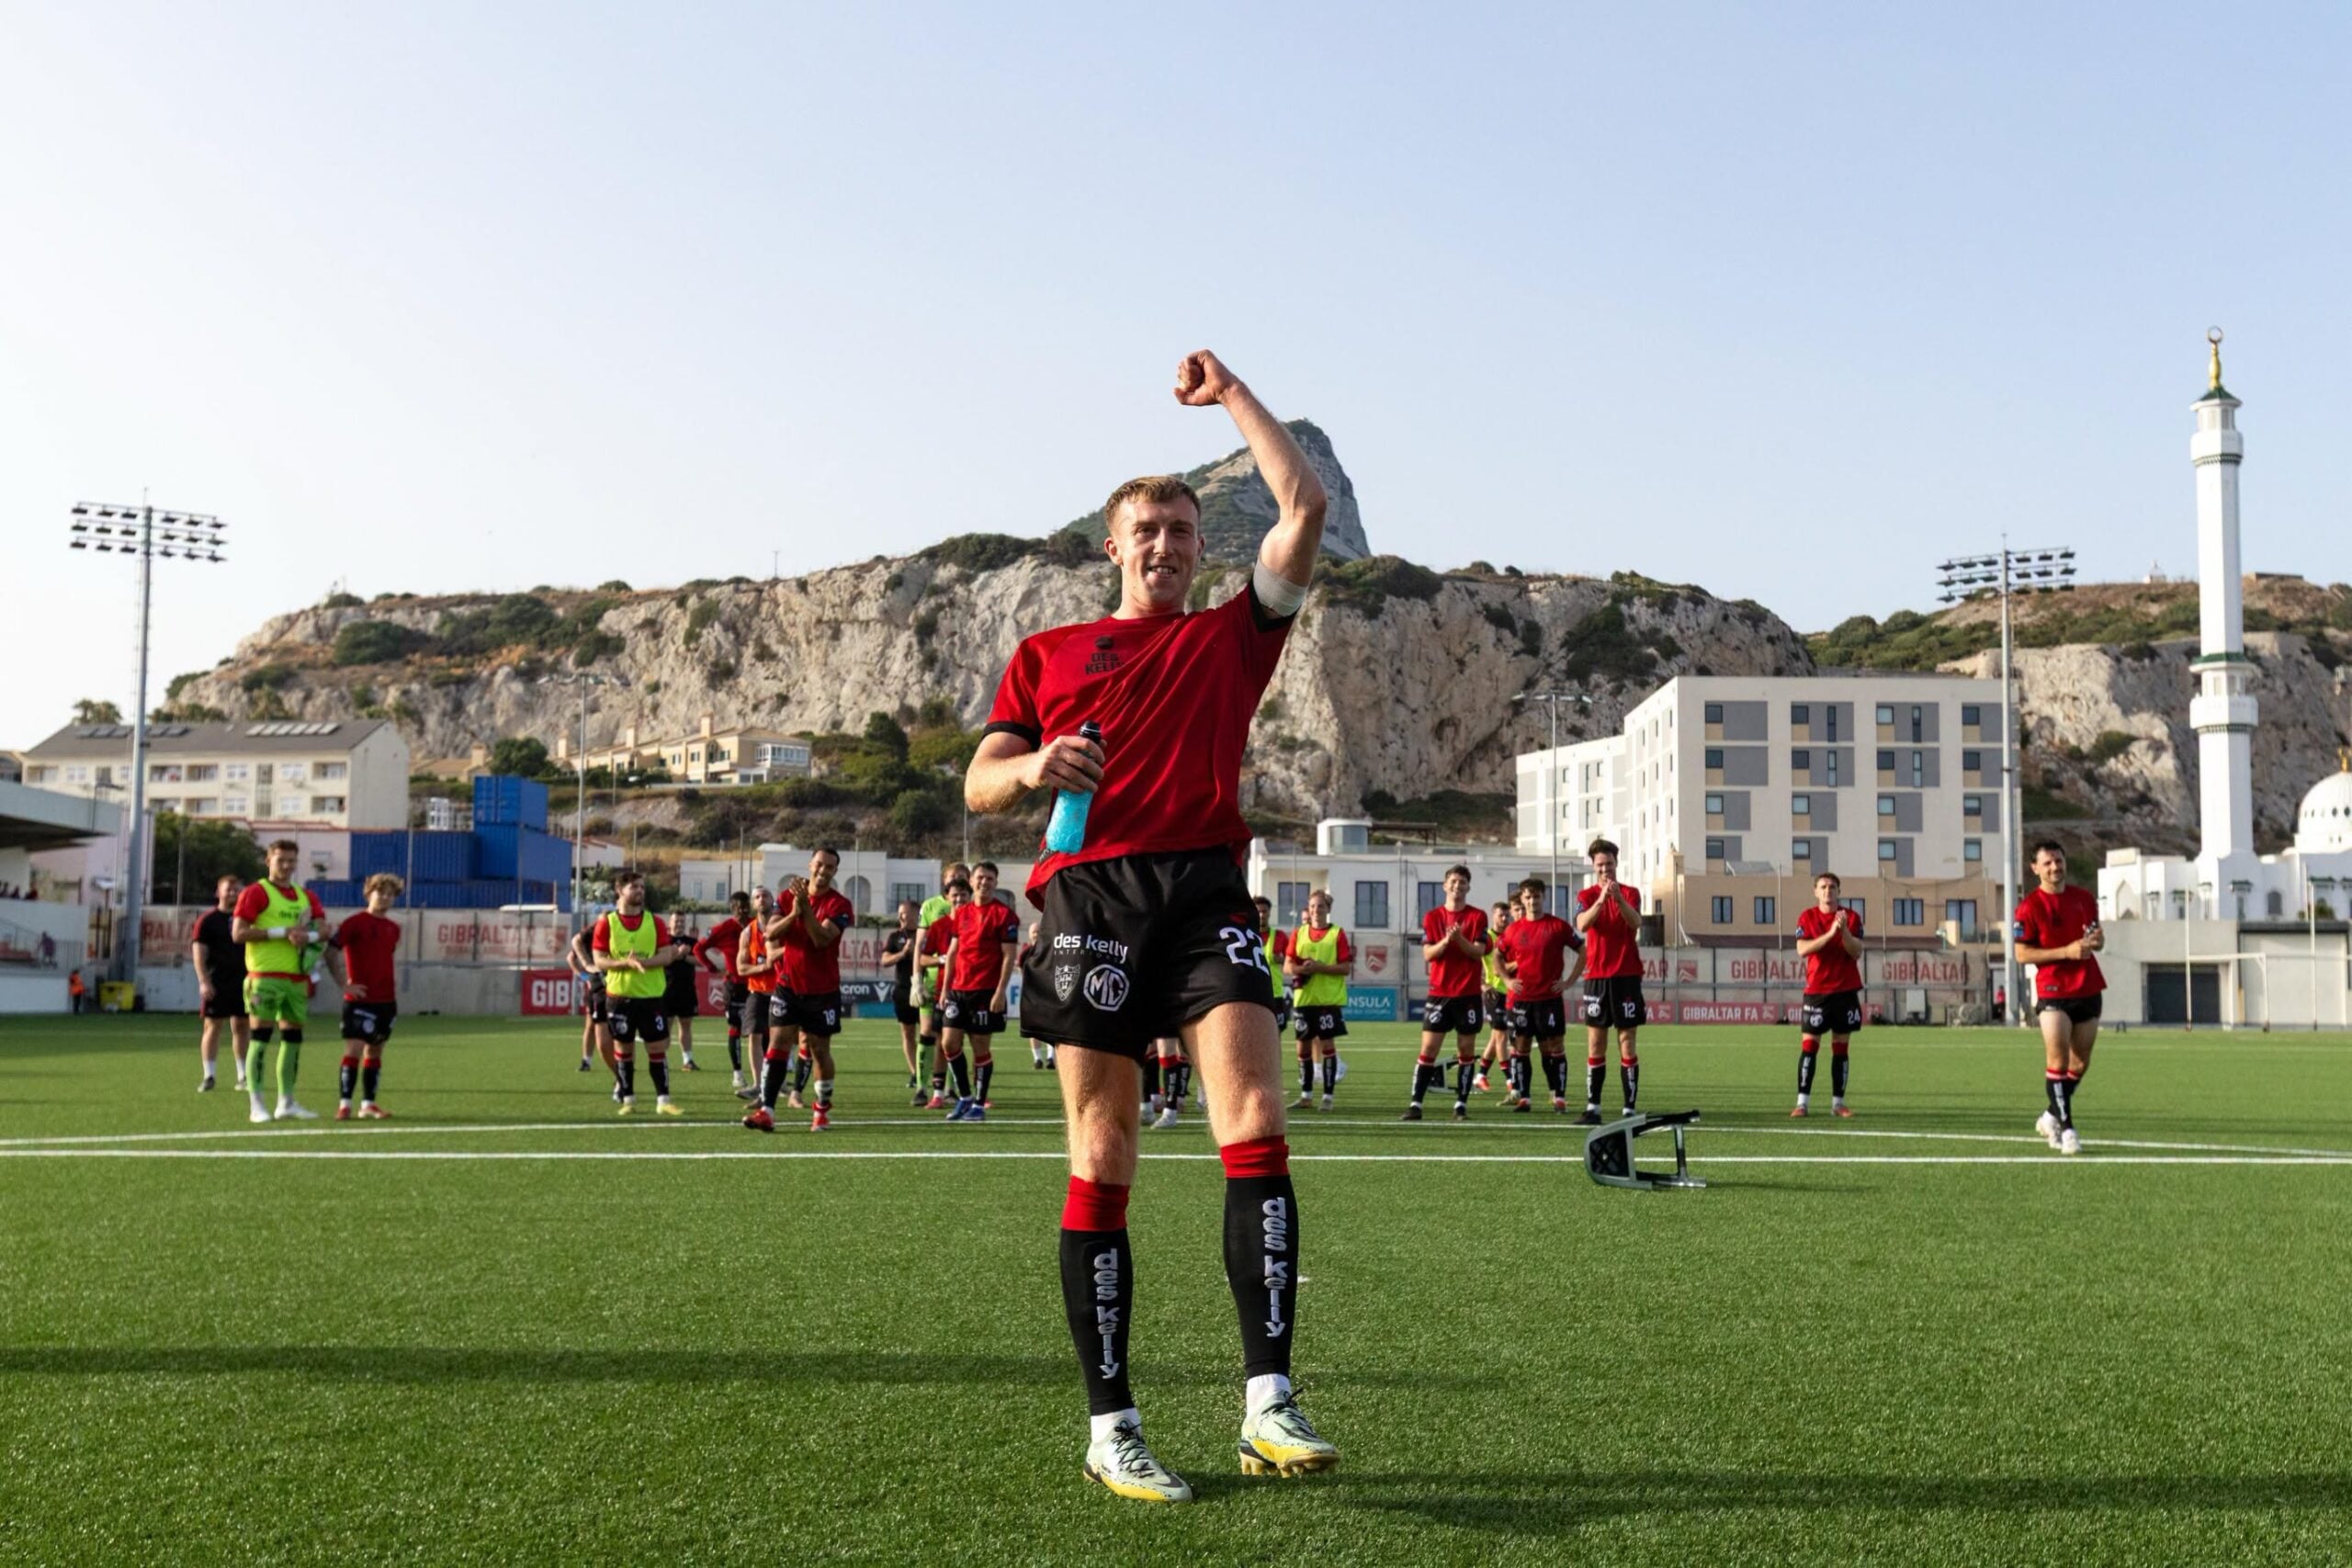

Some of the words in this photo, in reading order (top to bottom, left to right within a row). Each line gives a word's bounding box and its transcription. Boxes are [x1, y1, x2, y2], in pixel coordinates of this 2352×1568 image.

[1054, 933, 1081, 949] des
[1085, 934, 1128, 964] kelly
[1219, 927, 1269, 976] 22
[1731, 961, 1807, 980] GIBRALTA
[840, 984, 869, 995] cron
[1089, 968, 1125, 1007] MG
[1348, 997, 1390, 1008] NSULA
[1623, 1002, 1635, 1019] 12
[1683, 1008, 1741, 1021] GIBRALTAR
[1746, 1008, 1758, 1021] FA
[655, 1015, 664, 1031] 3
[1319, 1014, 1334, 1030] 33
[1262, 1197, 1287, 1252] des
[1094, 1248, 1118, 1301] des
[1263, 1255, 1288, 1337] kelly
[1097, 1305, 1120, 1379] kelly
